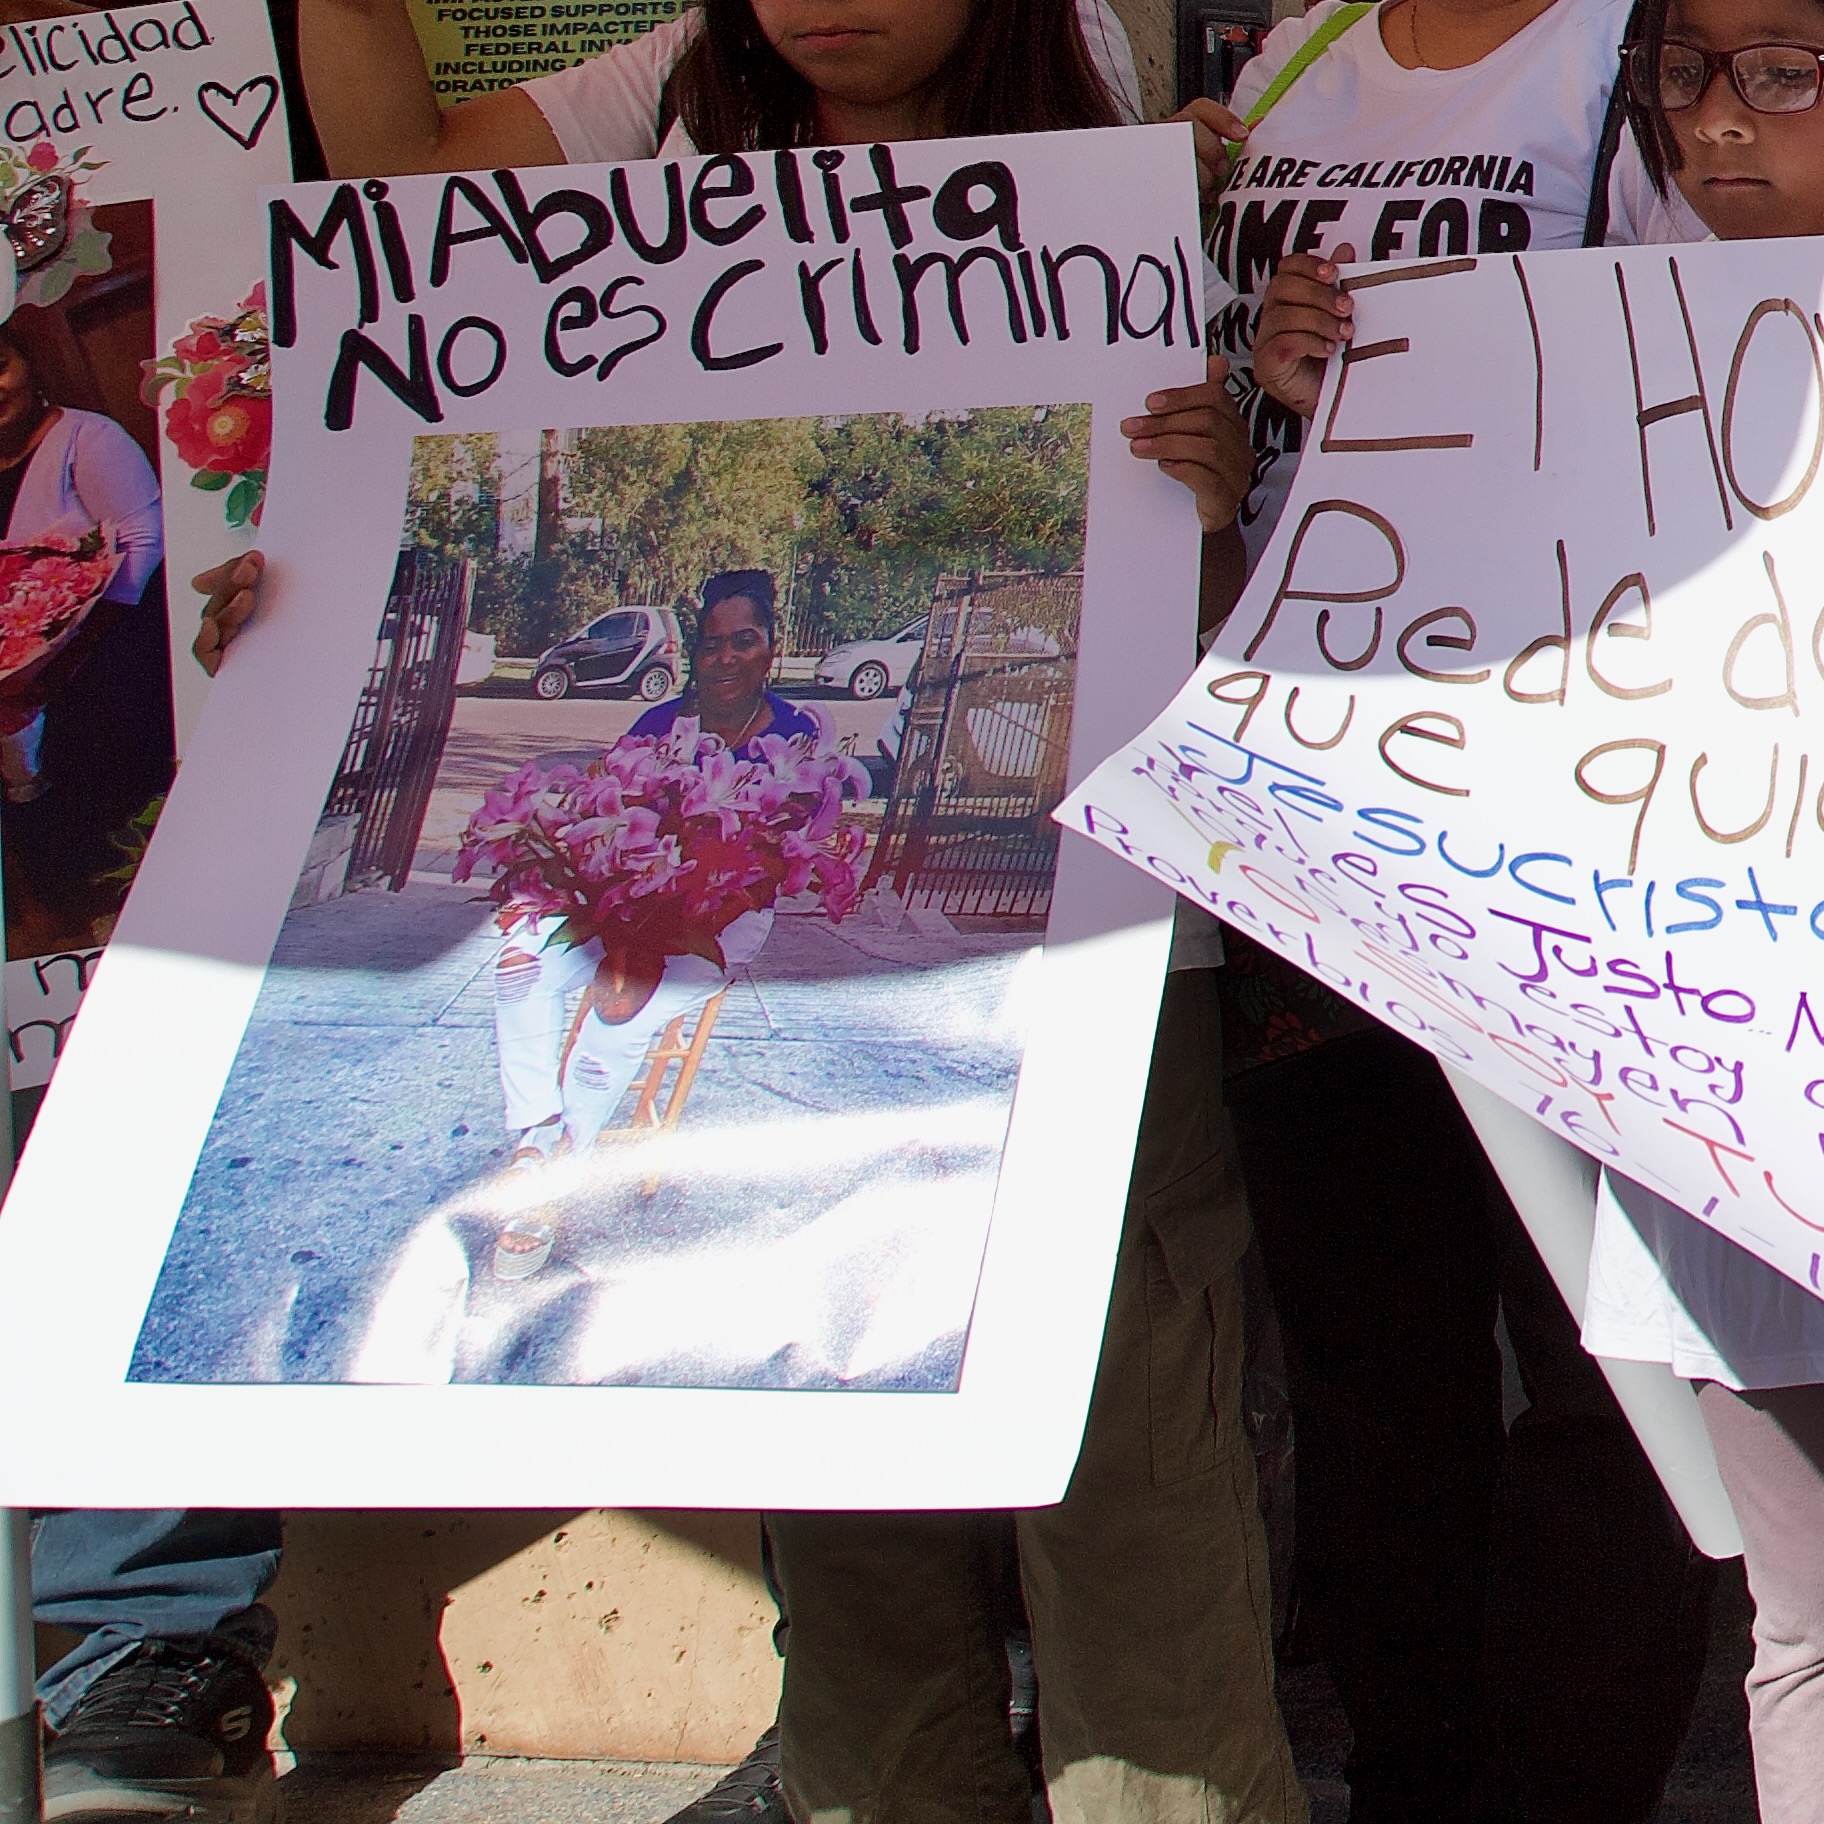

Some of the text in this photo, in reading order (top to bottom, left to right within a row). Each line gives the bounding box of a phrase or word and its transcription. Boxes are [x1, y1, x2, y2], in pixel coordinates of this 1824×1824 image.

[435, 60, 566, 74] INCLUDING
[437, 2, 677, 22] FOCUSED SUPPORTS
[460, 24, 537, 38] THOSE
[464, 41, 576, 56] FEDERAL
[1245, 155, 1533, 197] ARE CALIFORNIA
[267, 144, 1023, 348] Mi Abuelita
[324, 315, 508, 430] No
[545, 277, 668, 381] es
[691, 236, 1200, 371] Criminal
[1319, 255, 1543, 471] El
[1243, 498, 1673, 708] Puede
[1204, 670, 1470, 798] que
[1084, 805, 1474, 1066] Proverbios
[1487, 907, 1756, 1024] Justo
[1519, 982, 1744, 1103] estoy
